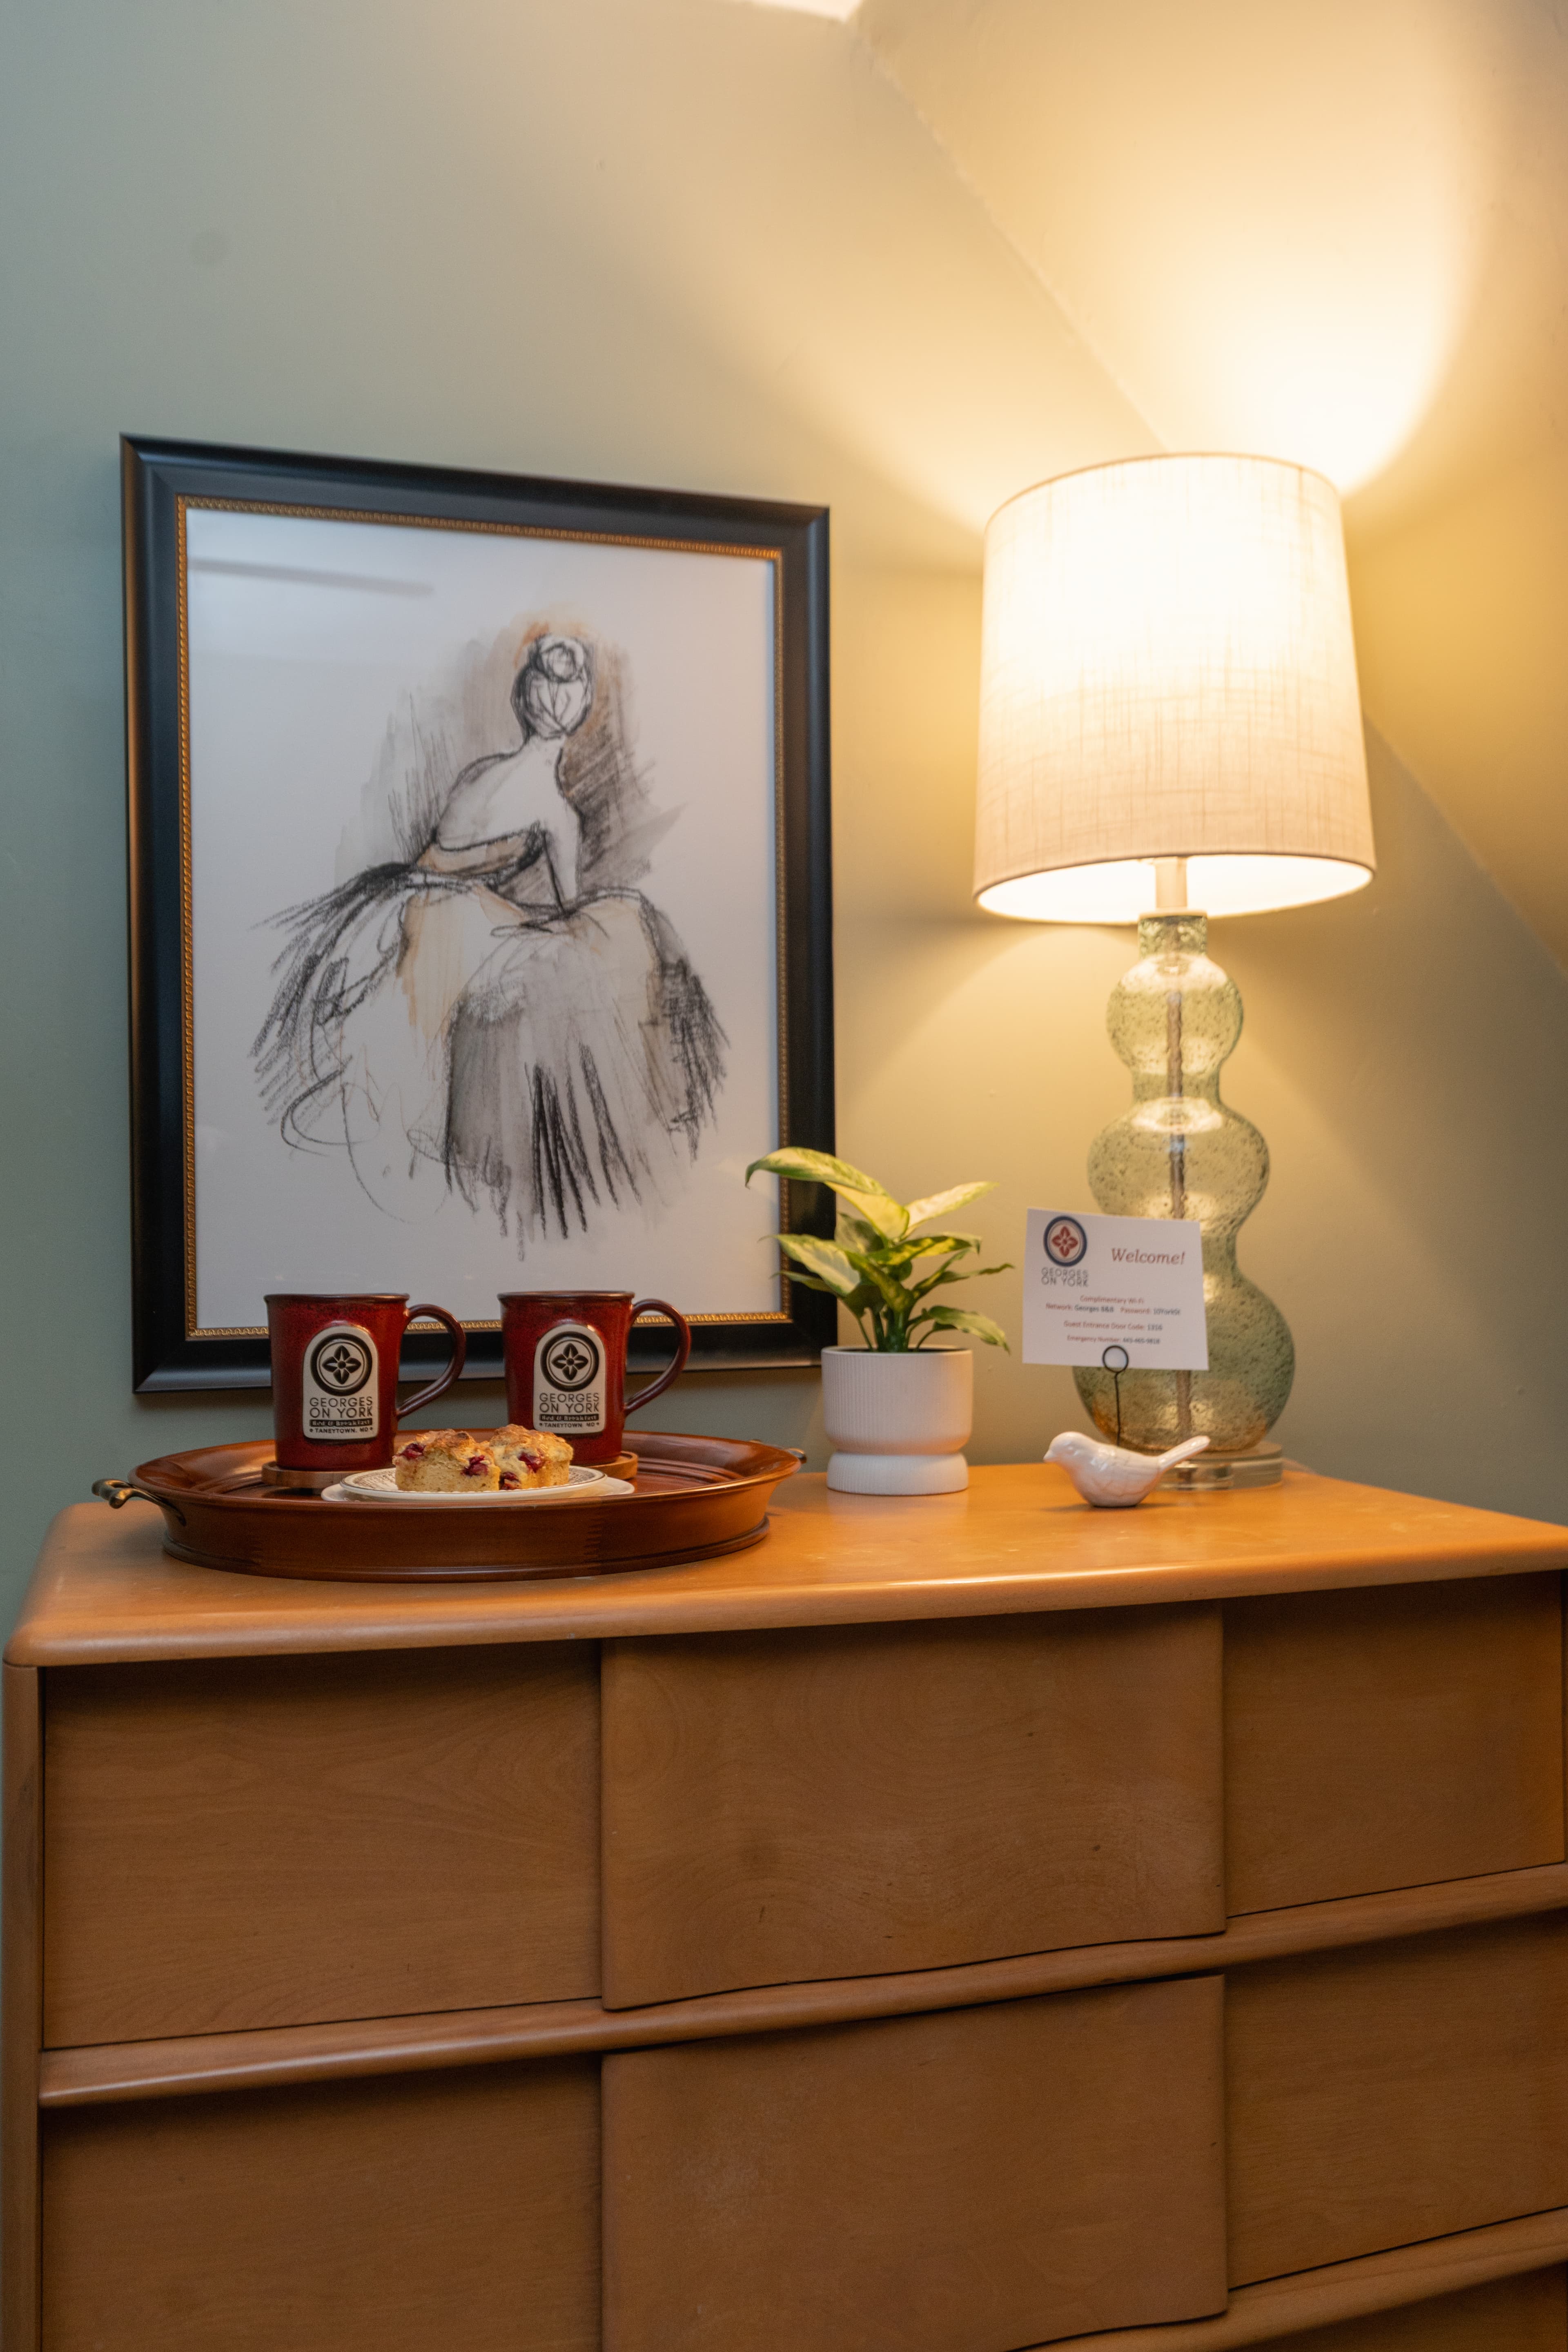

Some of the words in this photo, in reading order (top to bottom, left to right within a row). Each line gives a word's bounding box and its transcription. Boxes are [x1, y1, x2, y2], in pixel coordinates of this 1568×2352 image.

[1111, 1247, 1185, 1265] Welcome!
[1041, 1267, 1089, 1278] GEORGES
[1041, 1276, 1056, 1285] ON
[1062, 1277, 1088, 1287] YORK
[1080, 1295, 1126, 1304] Complimentary
[1074, 1304, 1099, 1313] Georges
[1067, 1334, 1096, 1343] Emergency
[310, 1396, 373, 1408] GEORGES
[539, 1392, 599, 1403] GEORGES
[310, 1407, 330, 1418] ON
[336, 1406, 372, 1418] YORK
[539, 1403, 559, 1413] ON
[565, 1402, 599, 1413] YORK
